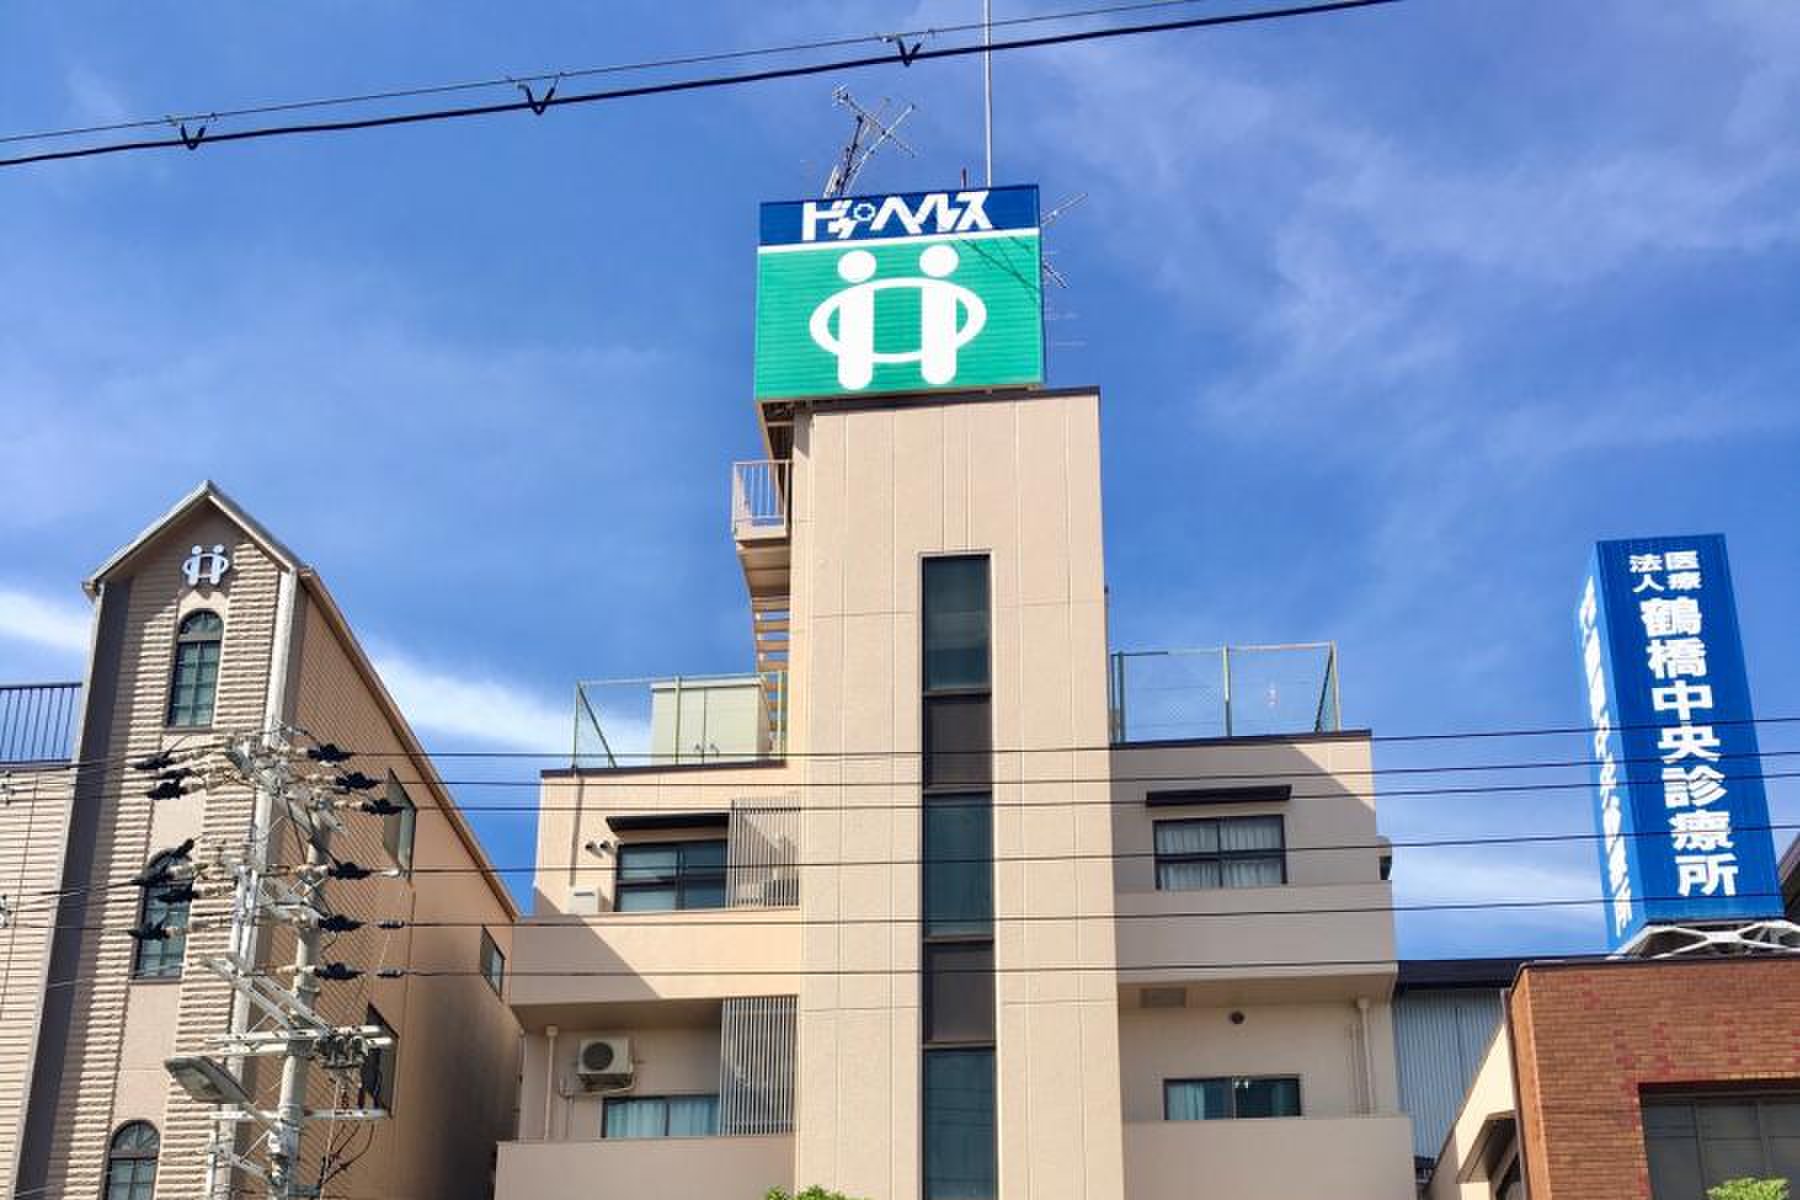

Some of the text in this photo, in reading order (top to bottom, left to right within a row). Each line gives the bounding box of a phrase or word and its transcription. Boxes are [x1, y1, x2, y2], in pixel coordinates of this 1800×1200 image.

[1639, 596, 1738, 897] 鶴橋中央診療所
